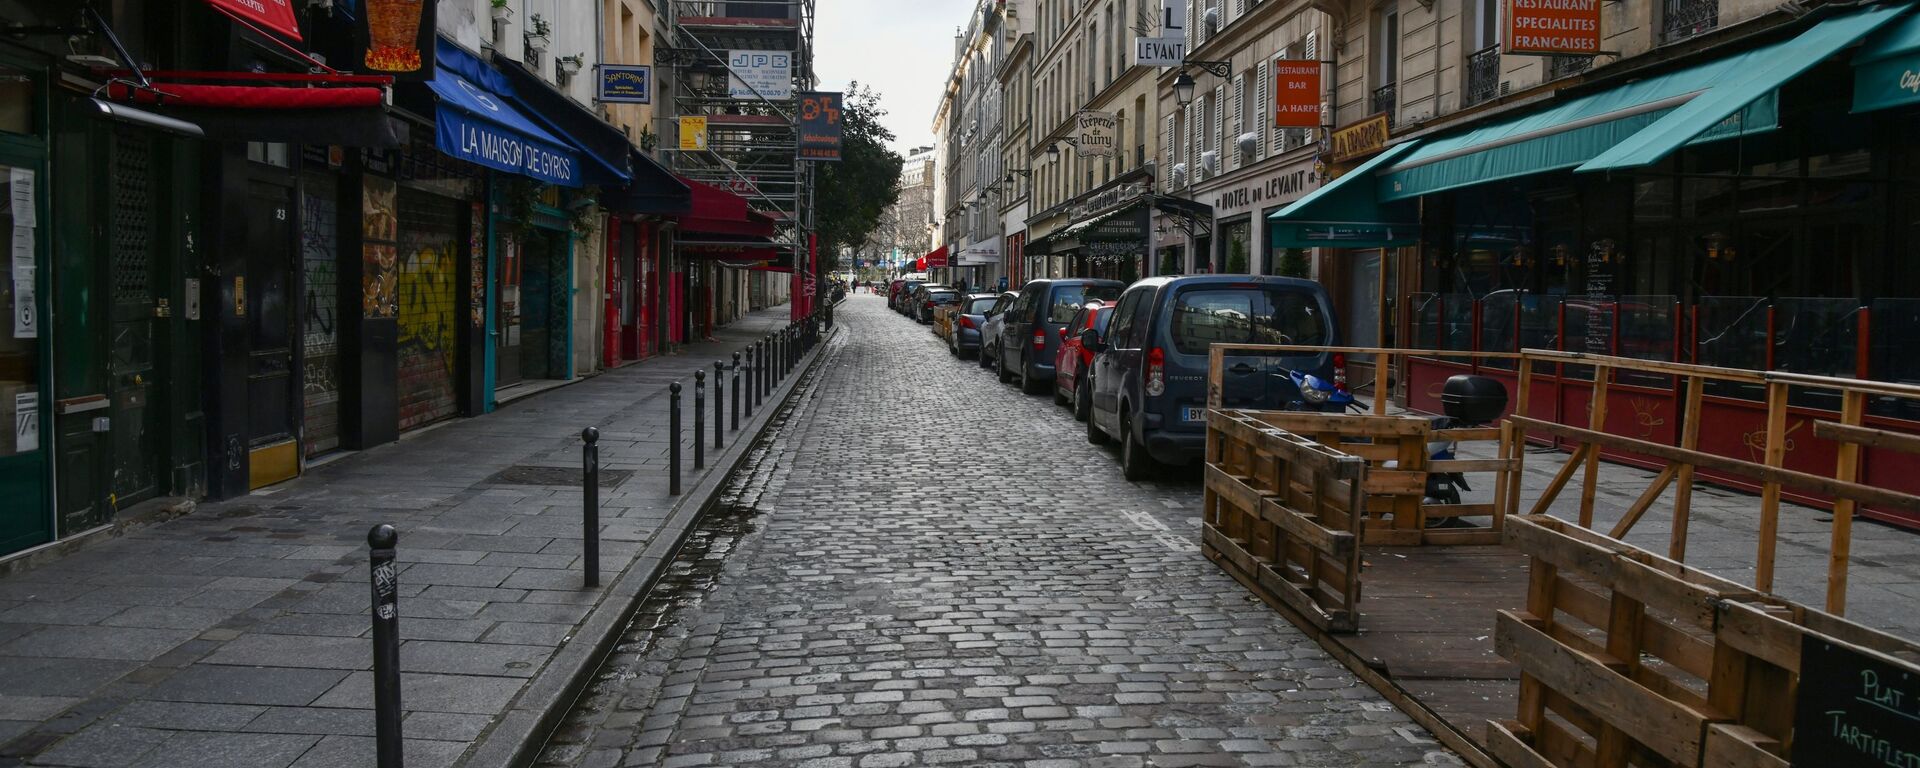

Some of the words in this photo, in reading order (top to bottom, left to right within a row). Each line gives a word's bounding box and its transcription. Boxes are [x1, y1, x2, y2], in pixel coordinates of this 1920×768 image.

[1515, 0, 1596, 11] RESTAURANT
[1515, 16, 1596, 31] SPECIALITES
[1138, 43, 1183, 61] LEVANT
[604, 72, 644, 84] SANTORINI
[1277, 66, 1319, 76] RESTAURANT
[1288, 81, 1307, 90] BAR
[1899, 69, 1920, 93] Caf
[1277, 104, 1287, 113] LA
[1290, 104, 1319, 113] HARPE
[1079, 114, 1115, 129] Crêperie
[1092, 127, 1101, 136] de
[462, 123, 479, 156] LA
[481, 130, 523, 167] MAISON
[525, 146, 540, 173] DE
[1081, 133, 1112, 148] Cluny
[1222, 187, 1249, 210] HOTEL
[1253, 187, 1262, 203] DU
[1265, 170, 1305, 199] LEVANT
[276, 208, 286, 220] 23
[1860, 669, 1905, 707] PLAT
[1825, 710, 1920, 768] TARTIFLET
